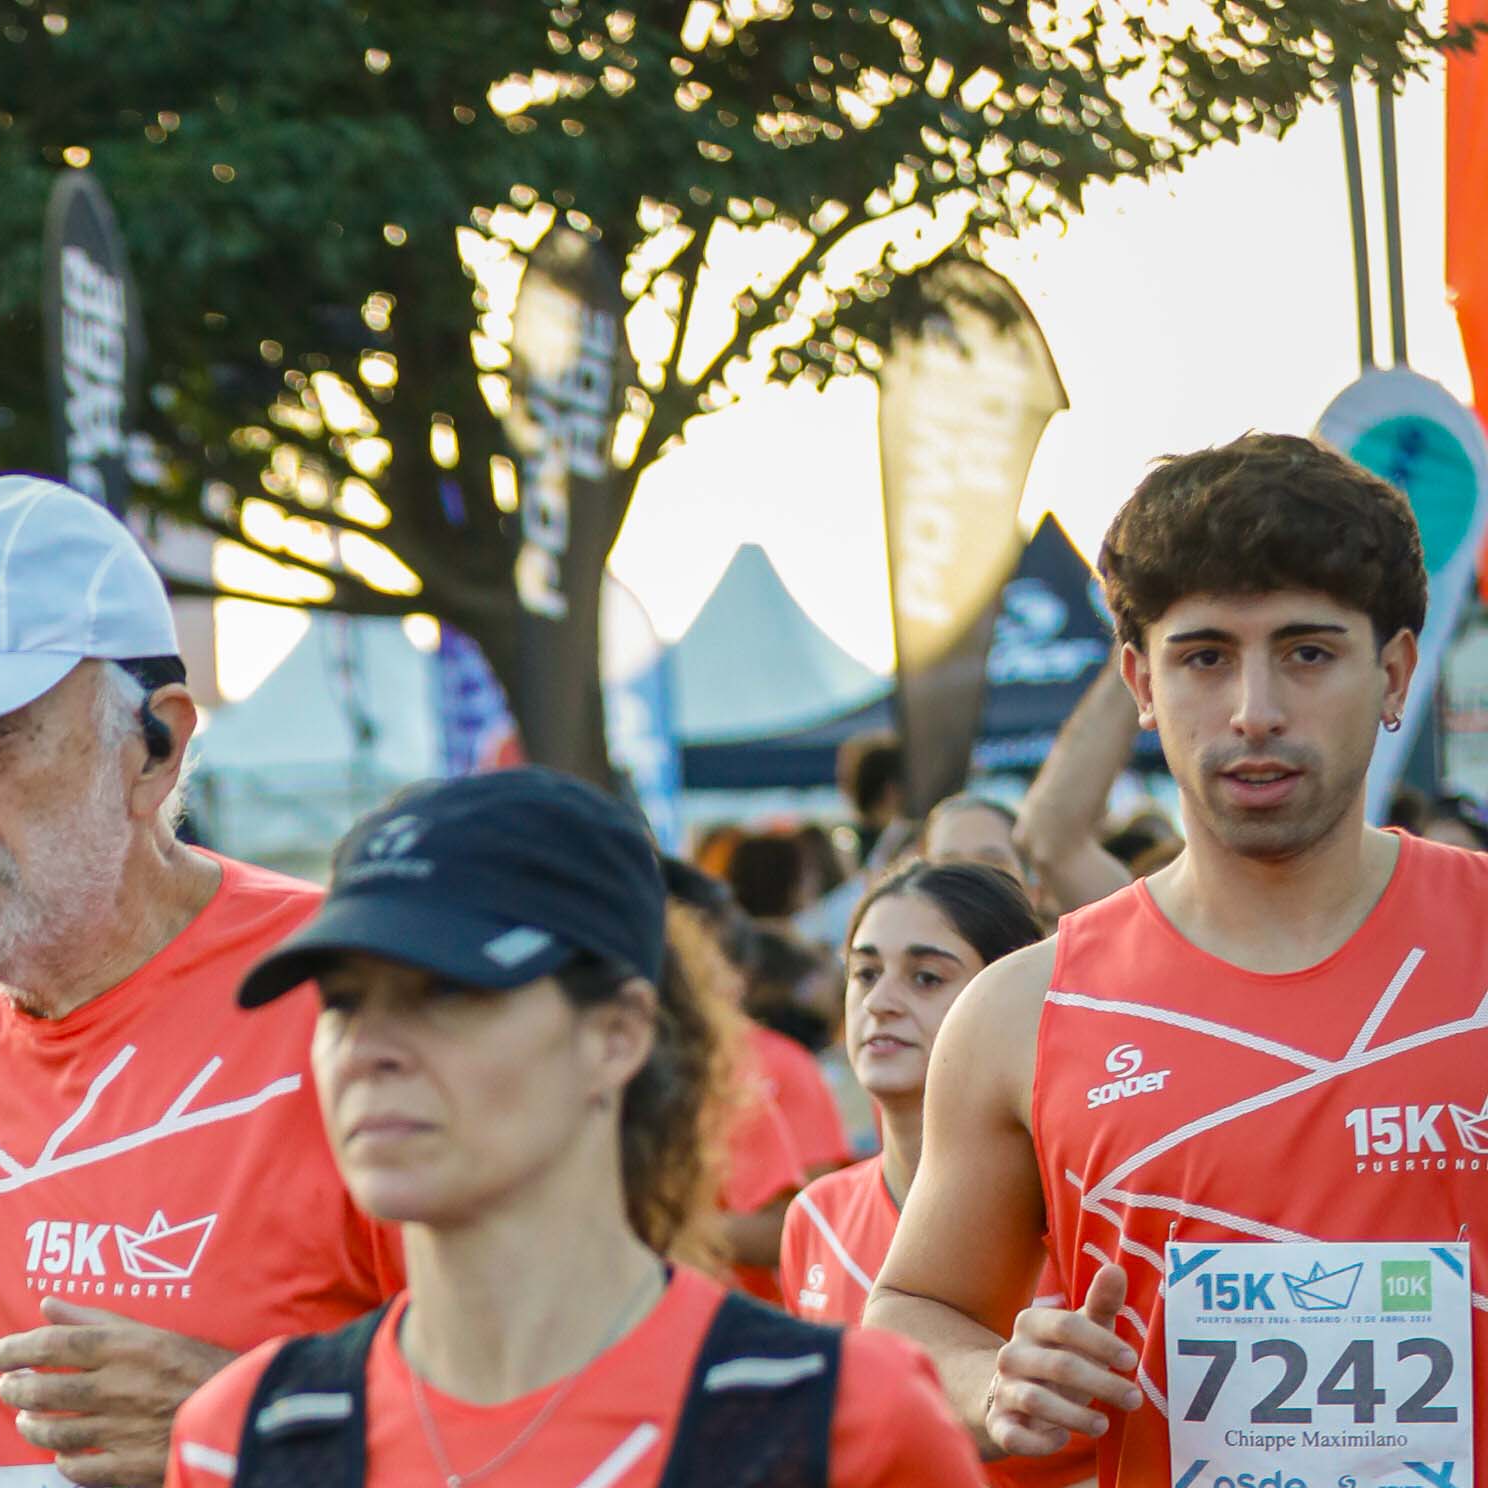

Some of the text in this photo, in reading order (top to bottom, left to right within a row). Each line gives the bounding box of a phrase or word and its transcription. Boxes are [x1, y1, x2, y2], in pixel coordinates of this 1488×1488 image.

[1344, 1105, 1447, 1157] 15K
[1356, 1158, 1448, 1174] PUERTO
[25, 1220, 112, 1277] 15K
[26, 1276, 193, 1299] PUERTO NORTE
[1194, 1272, 1277, 1311] 15K
[1385, 1275, 1428, 1297] 10K
[1299, 1315, 1342, 1325] ROSARIO
[1379, 1315, 1406, 1324] ABRIL
[1177, 1336, 1459, 1425] 7242
[1223, 1429, 1409, 1451] Chiappe Maximilano
